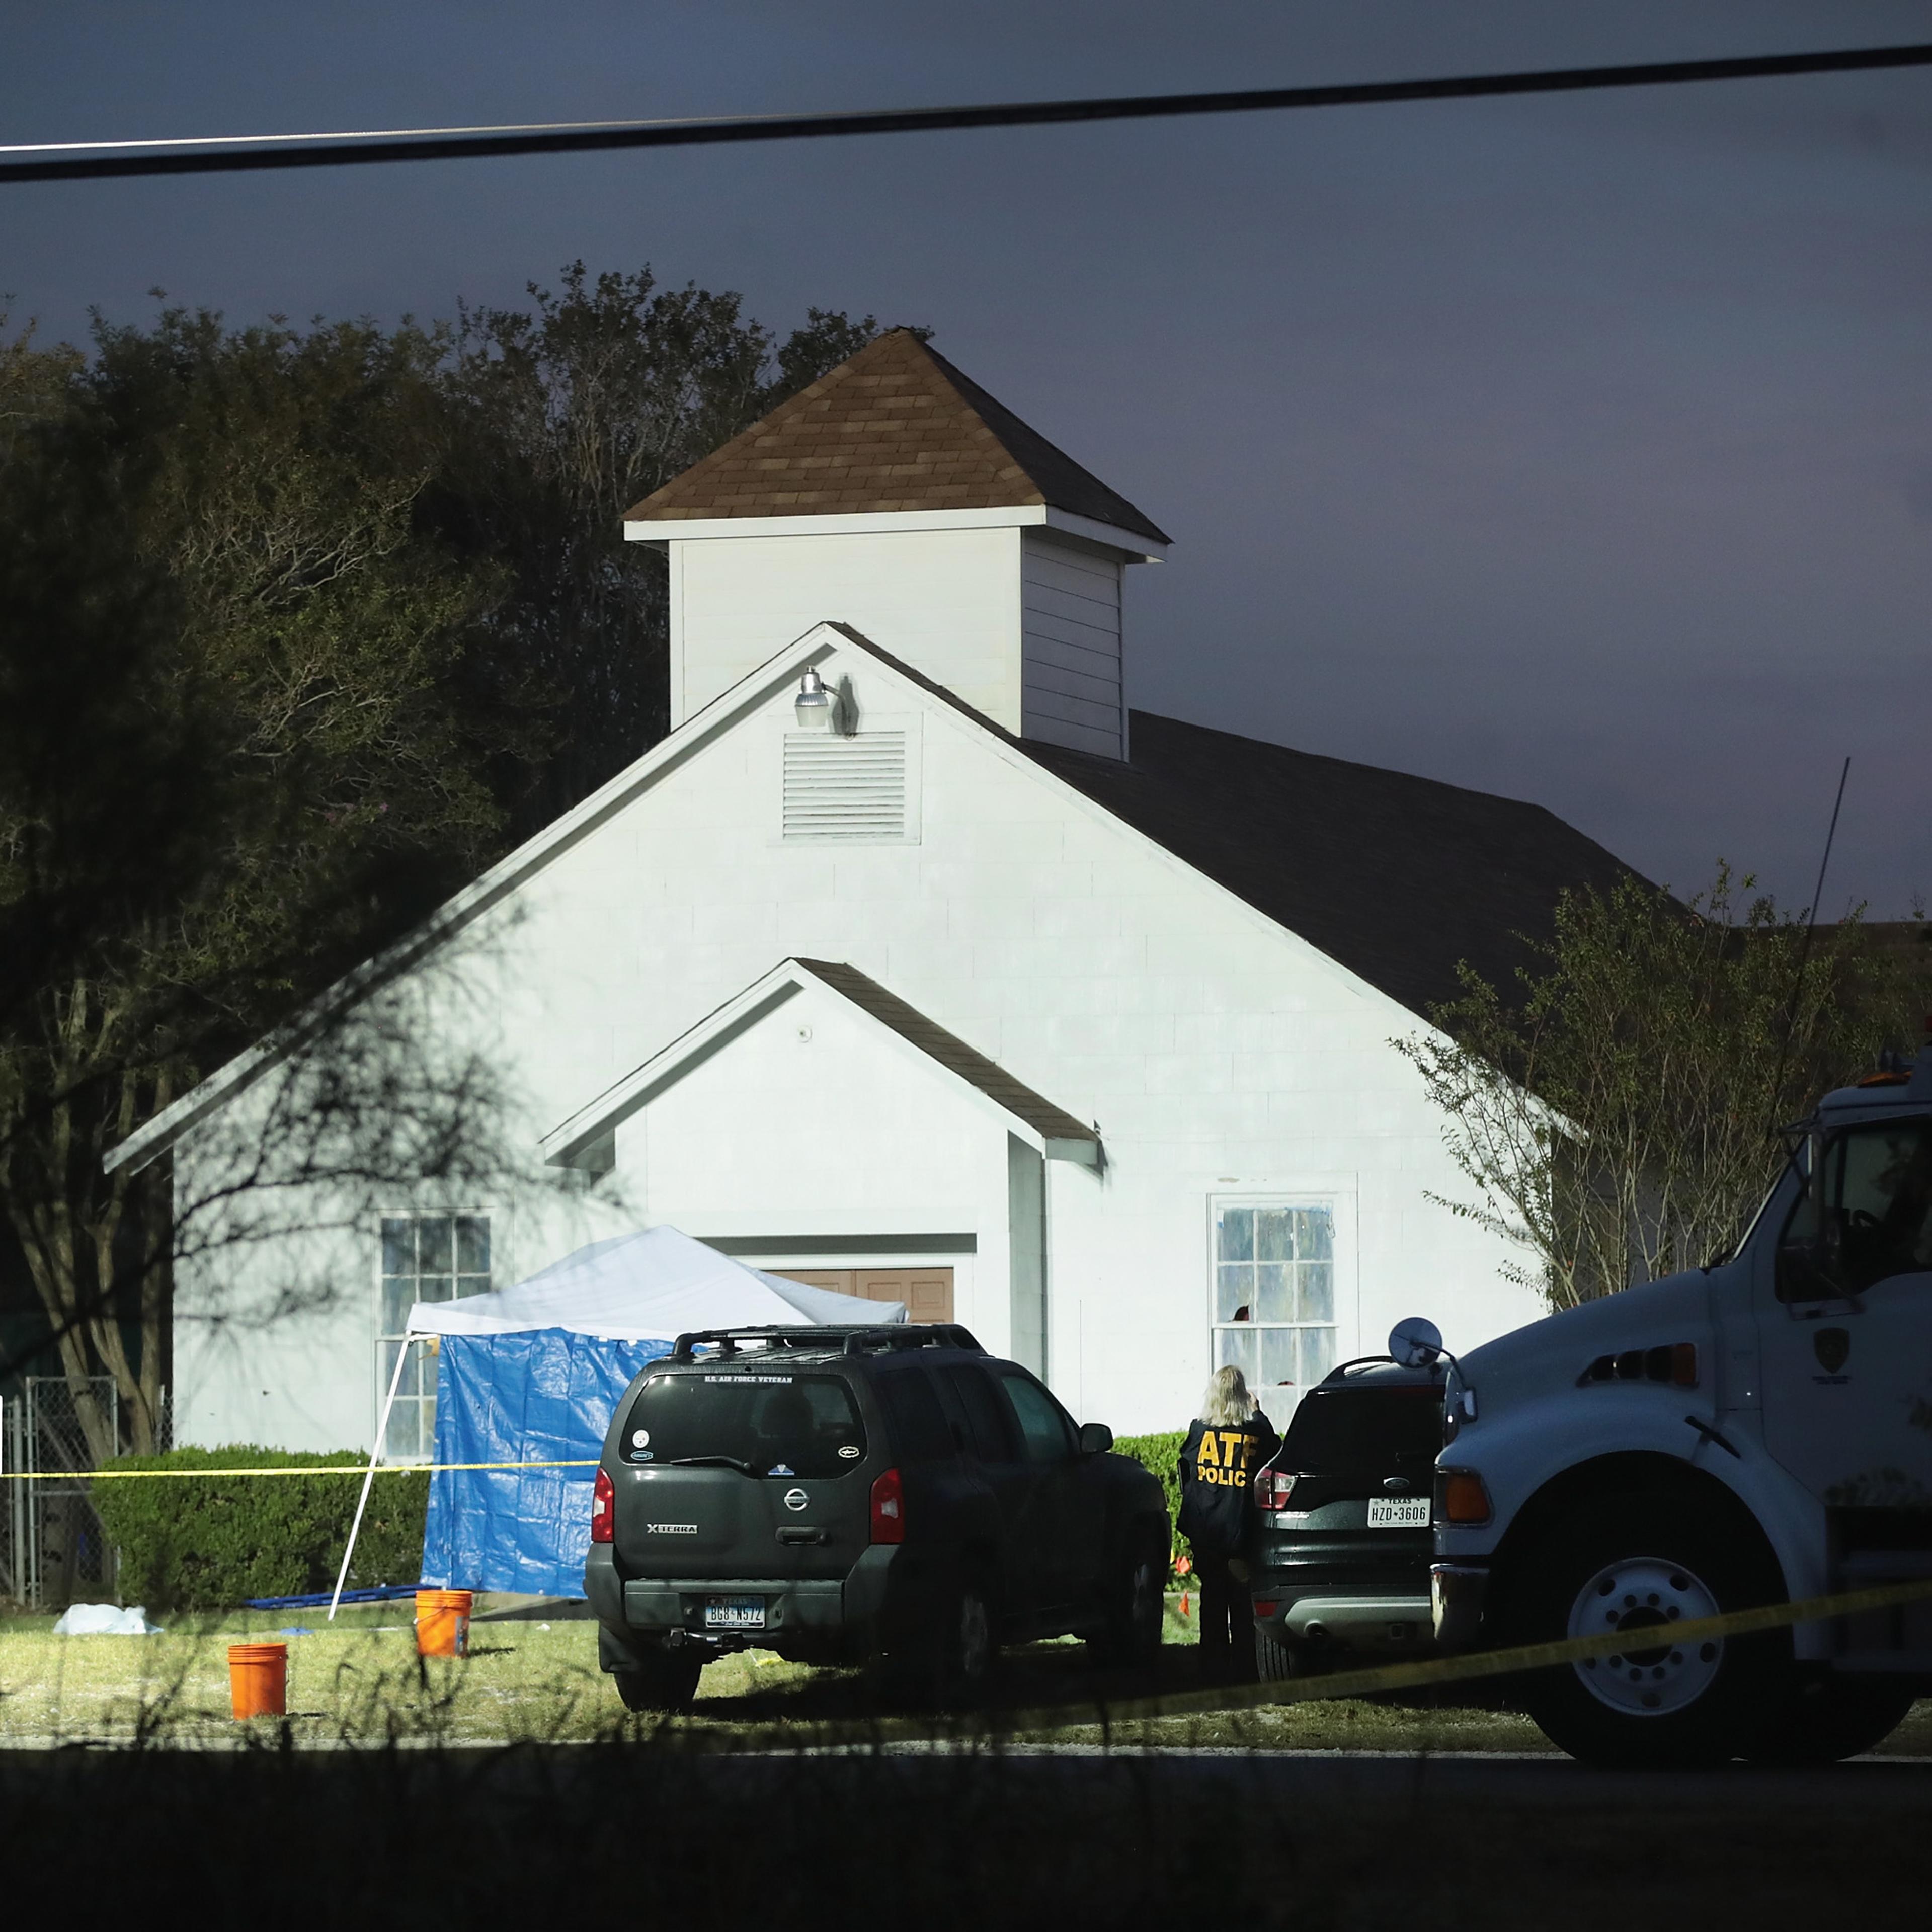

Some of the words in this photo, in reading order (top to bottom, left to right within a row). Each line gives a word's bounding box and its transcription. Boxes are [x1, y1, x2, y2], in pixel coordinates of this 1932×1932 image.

[1197, 1431, 1259, 1469] ATF
[1197, 1465, 1253, 1487] POLIC
[647, 1524, 697, 1534] XTERRA
